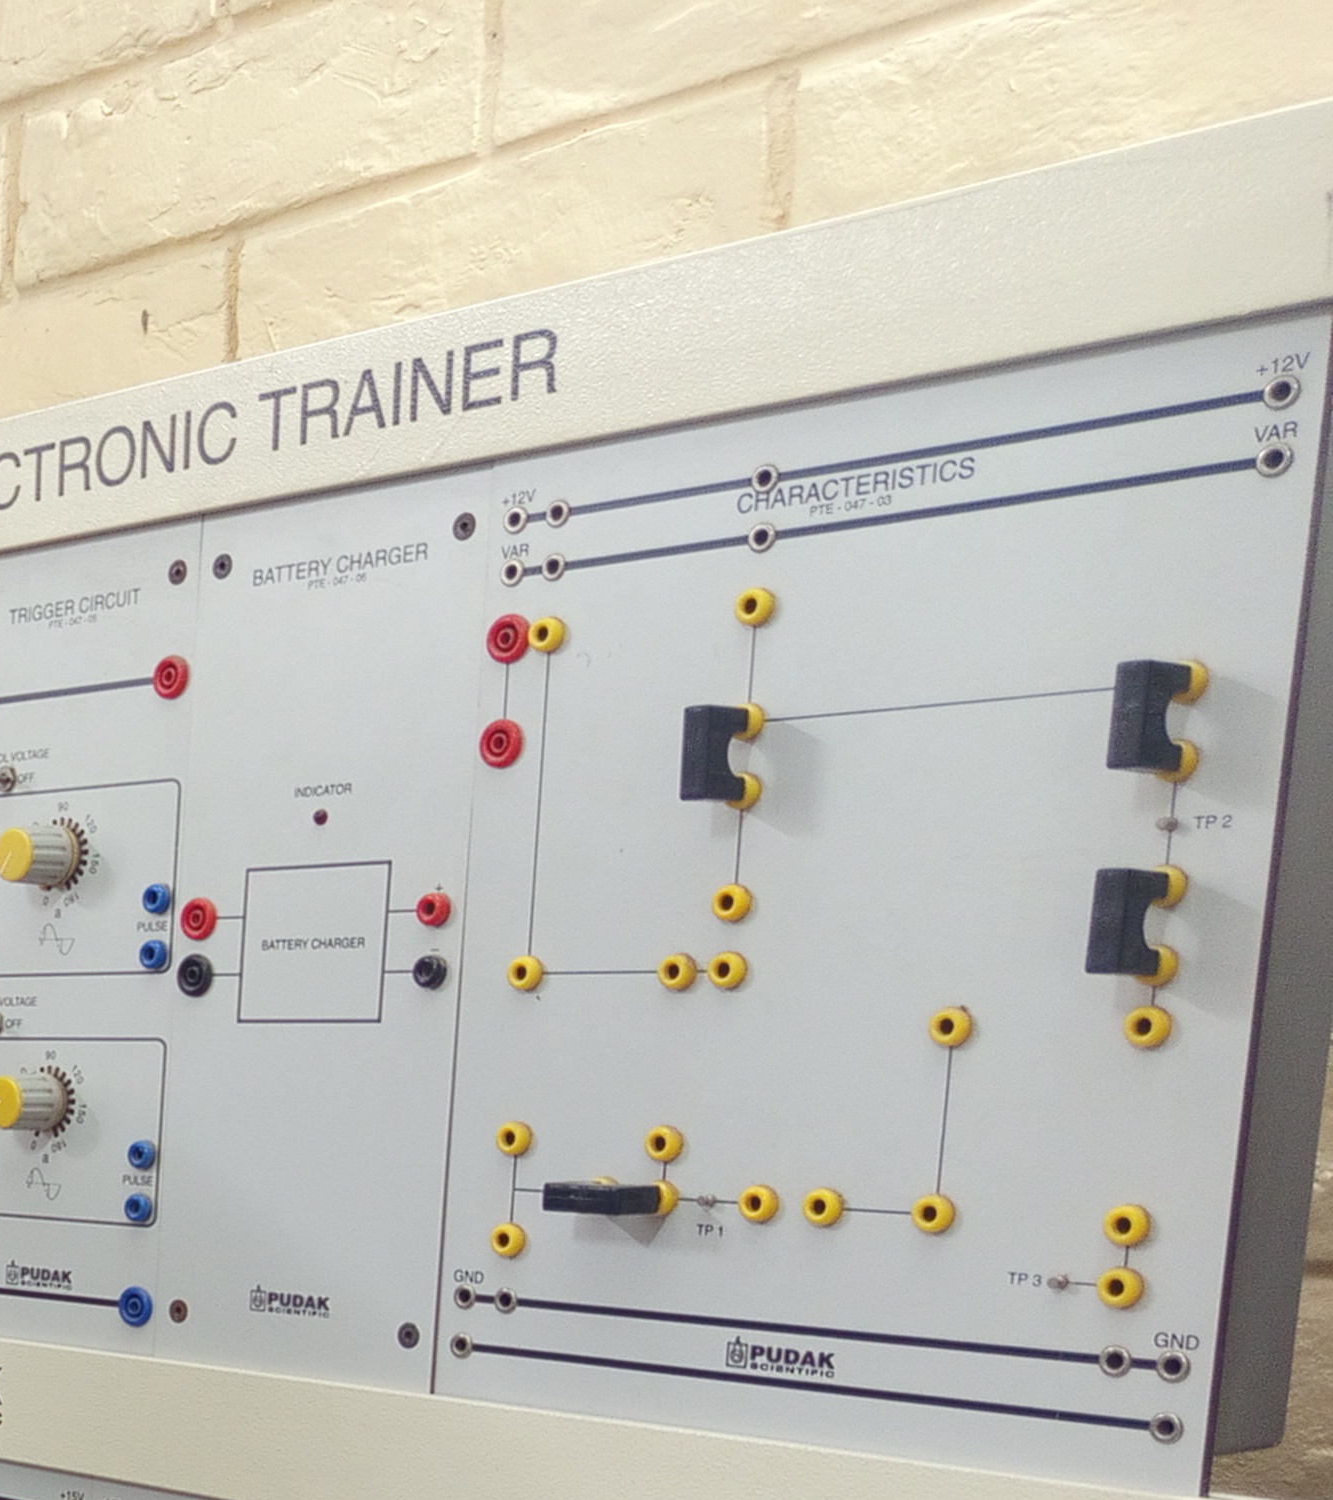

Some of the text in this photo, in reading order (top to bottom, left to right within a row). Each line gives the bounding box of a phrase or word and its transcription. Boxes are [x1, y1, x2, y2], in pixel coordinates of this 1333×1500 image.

[1255, 352, 1311, 377] +12V
[259, 328, 559, 452] TRAINER
[1253, 421, 1299, 444] VAR
[736, 456, 976, 516] CHARACTERISTICS
[502, 488, 536, 507] +12V
[809, 494, 893, 517] PTE 047 03
[502, 543, 530, 560] VAR
[252, 542, 429, 587] BATTERY CHARGER
[9, 587, 142, 626] TRIGGER CIRCUIT
[11, 748, 51, 763] VOLTAGE
[293, 782, 353, 799] INDICATOR
[1194, 815, 1217, 830] TP
[137, 921, 168, 932] PULSE
[261, 935, 366, 951] BATTERY CHARGER
[122, 1174, 153, 1186] PULSE
[21, 1267, 73, 1284] PUDAK
[453, 1268, 484, 1284] GND
[1008, 1271, 1029, 1285] TP
[268, 1292, 331, 1312] PUDAK
[1153, 1331, 1200, 1352] GND
[749, 1344, 835, 1369] PUDAK
[749, 1362, 835, 1380] SCIENTIFIC
